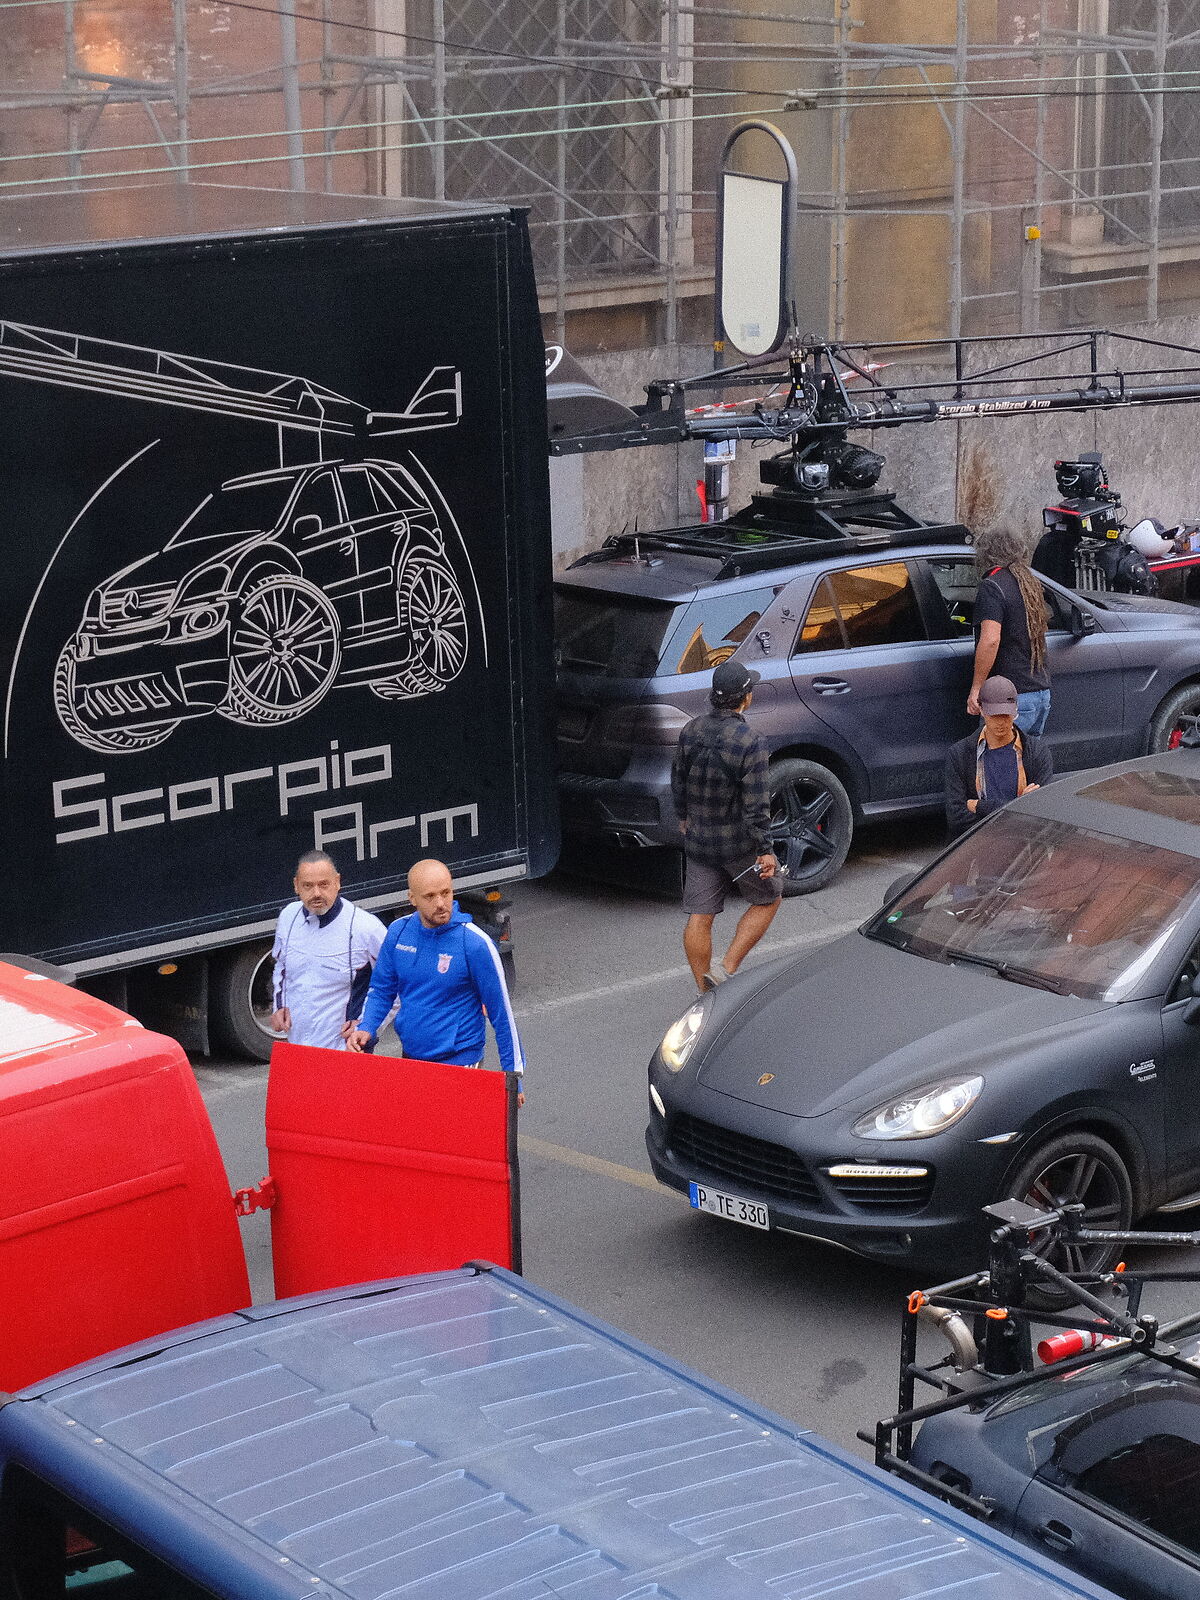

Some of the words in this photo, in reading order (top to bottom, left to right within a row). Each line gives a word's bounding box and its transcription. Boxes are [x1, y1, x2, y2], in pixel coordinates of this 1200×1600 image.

[939, 404, 975, 415] Scorpio
[978, 400, 1027, 415] Stabilized
[1029, 399, 1051, 409] Arm
[53, 740, 393, 844] Scorpio
[313, 802, 480, 861] Arm
[698, 1188, 707, 1207] P
[716, 1194, 736, 1217] TE
[739, 1201, 767, 1226] 330
